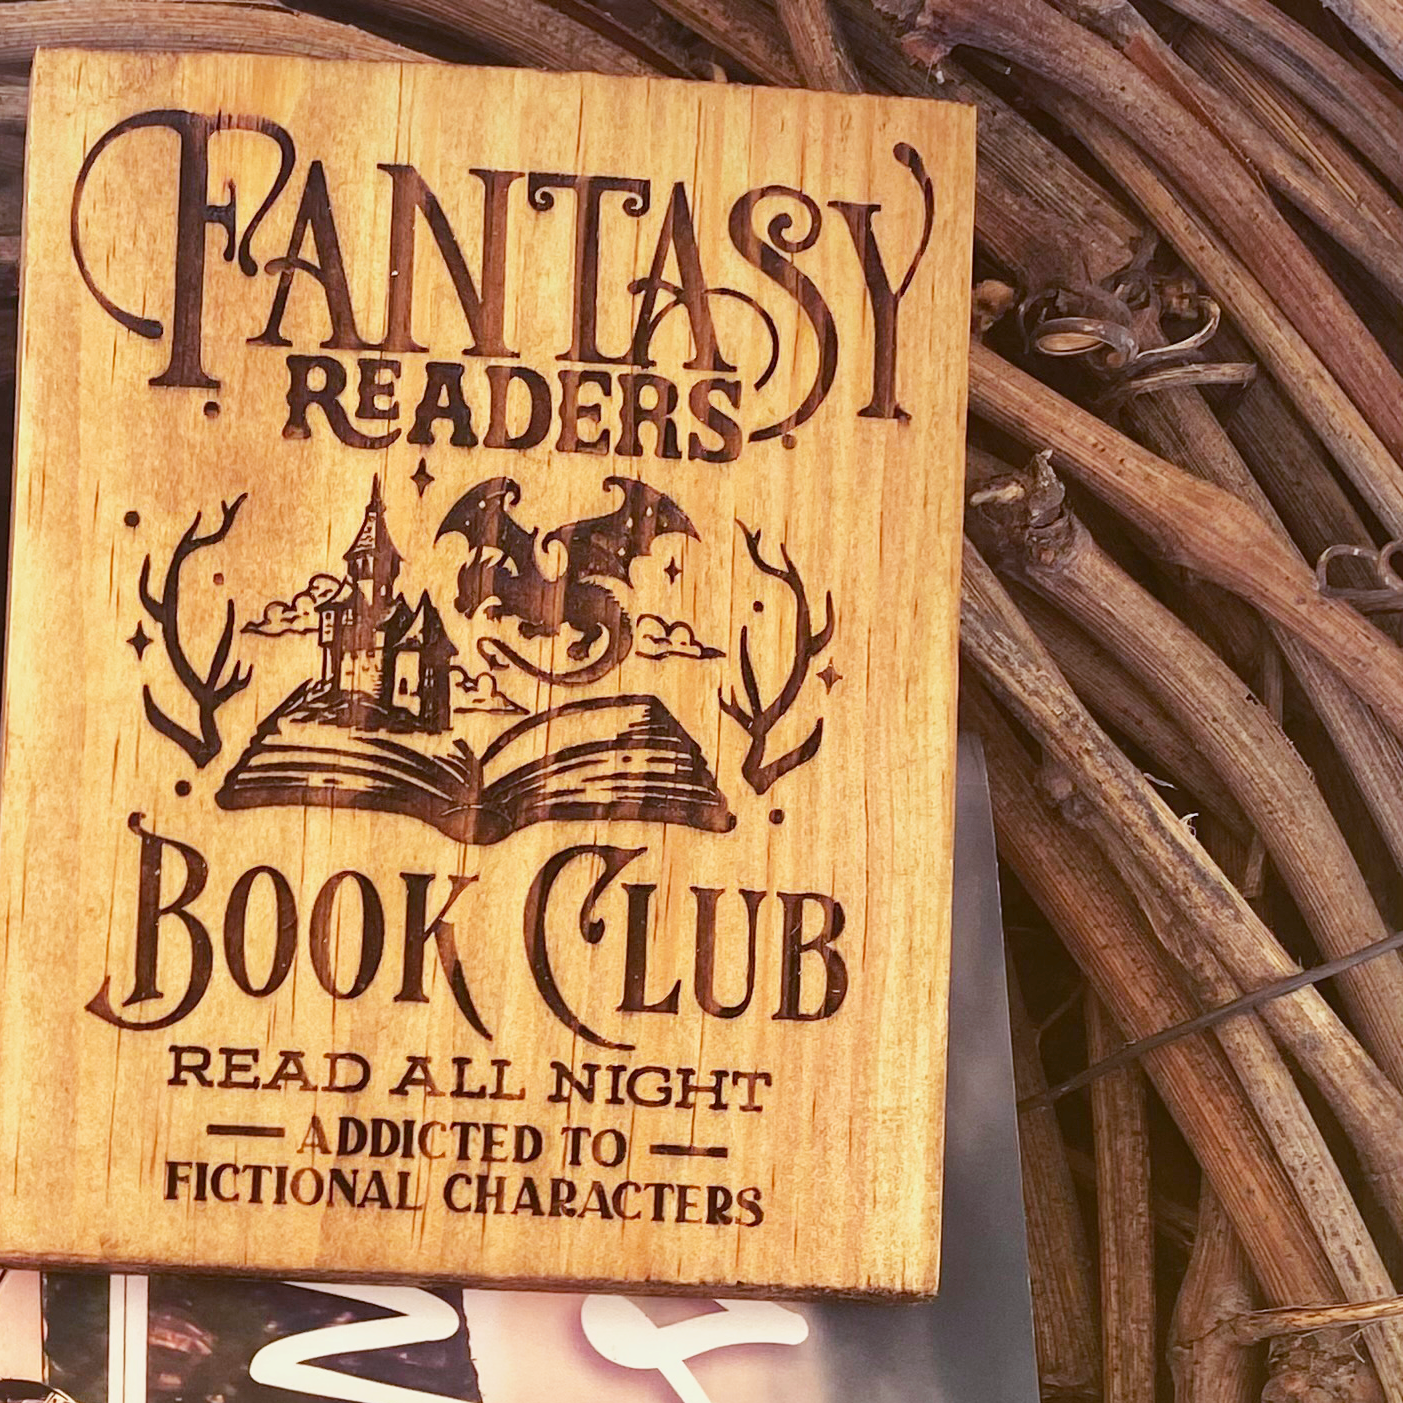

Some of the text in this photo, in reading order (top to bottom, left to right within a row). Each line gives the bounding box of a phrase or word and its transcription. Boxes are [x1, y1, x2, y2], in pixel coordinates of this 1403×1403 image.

[70, 109, 935, 448] FANTASY
[282, 355, 745, 464] READERS
[84, 812, 849, 1050] BOOK CLUB
[168, 1045, 772, 1113] READ ALL NIGHT
[298, 1115, 629, 1168] ADDICTED TO
[163, 1160, 764, 1228] FICTIONAL CHARACTERS
